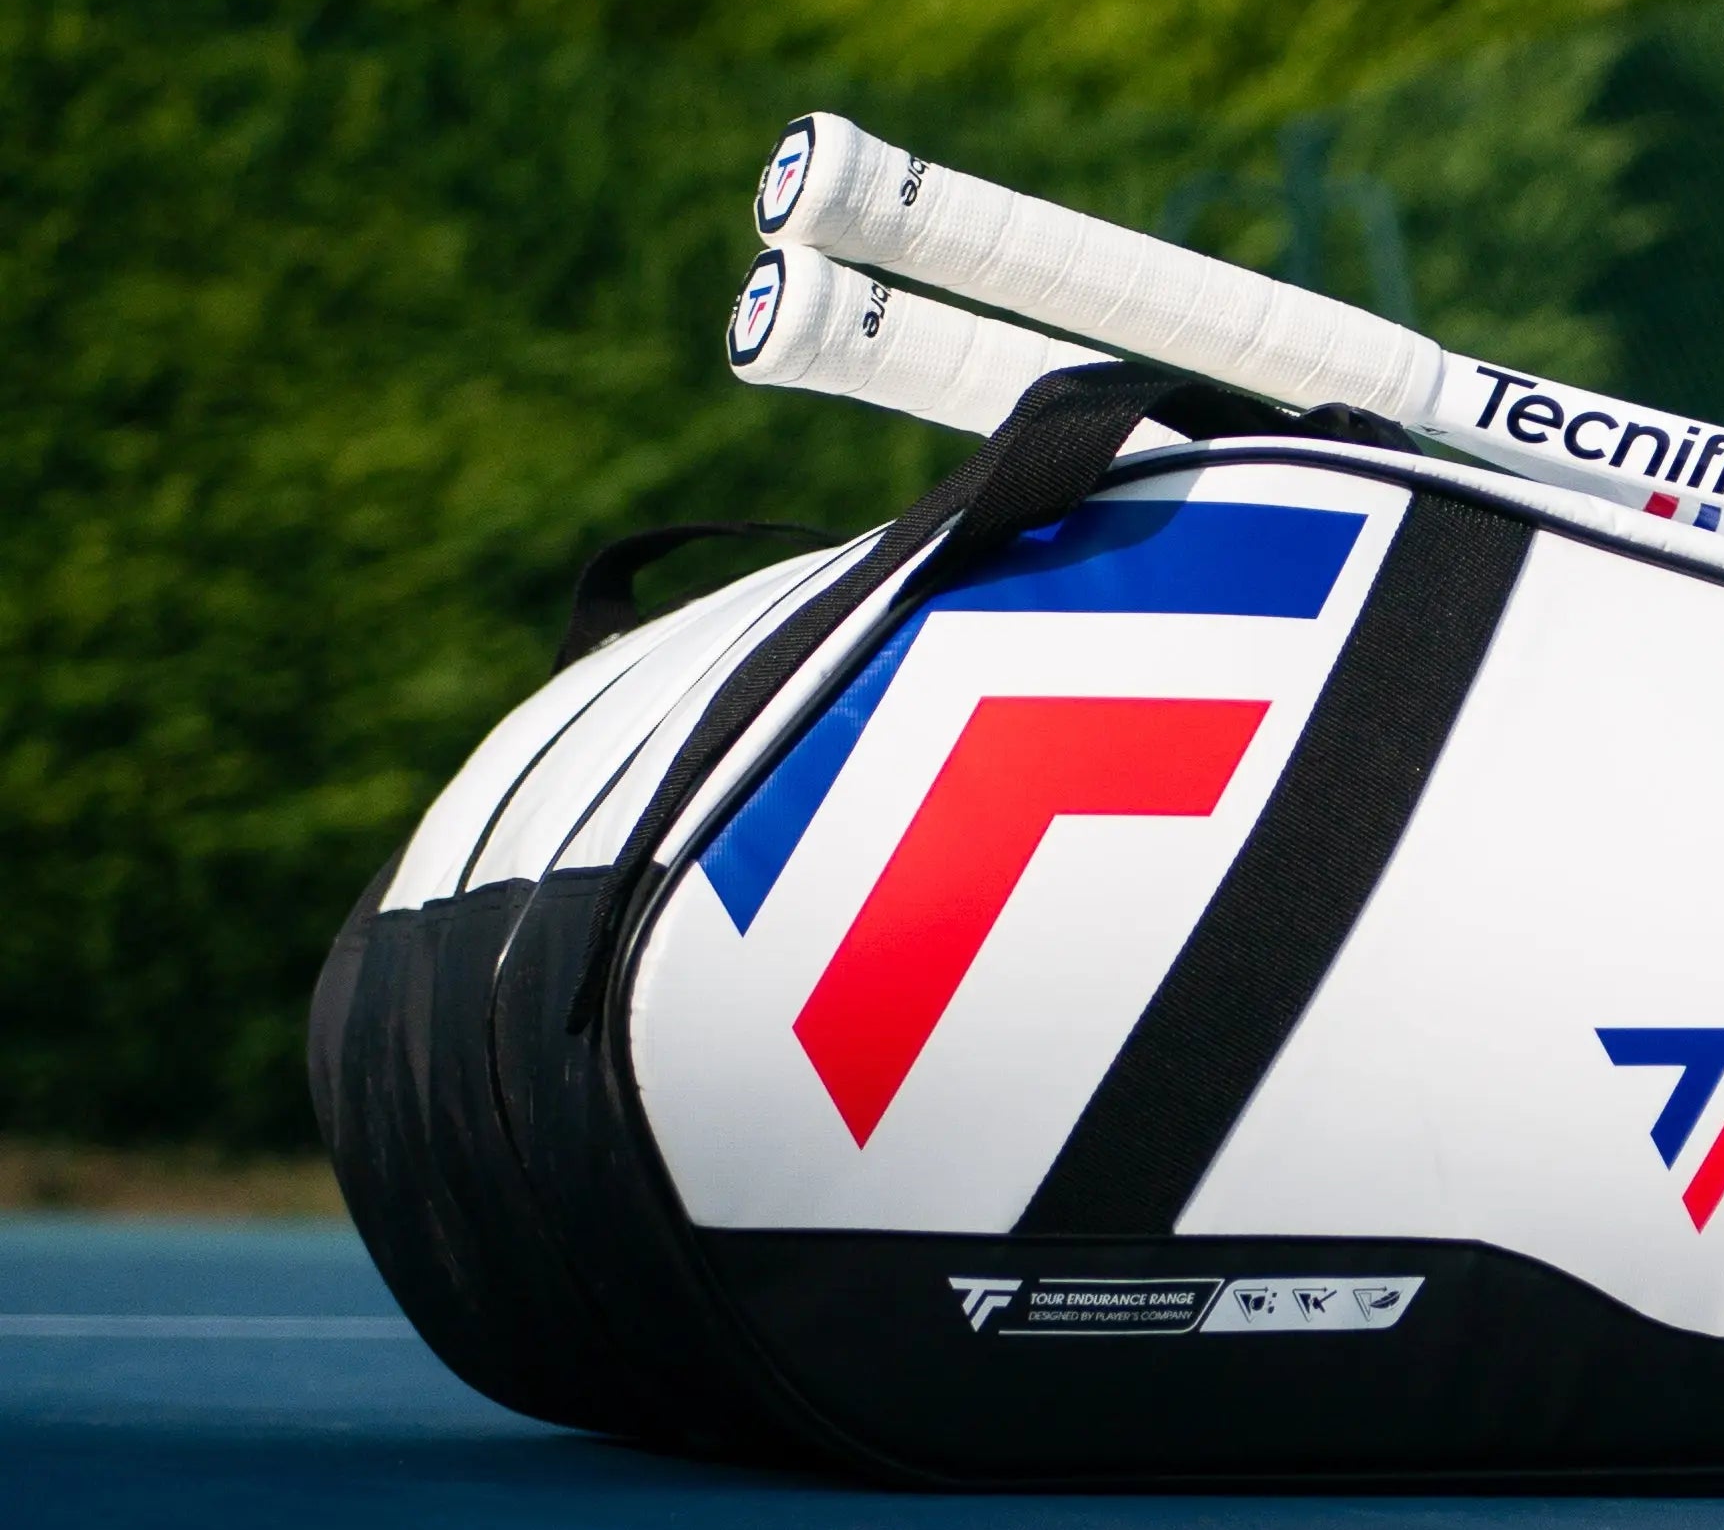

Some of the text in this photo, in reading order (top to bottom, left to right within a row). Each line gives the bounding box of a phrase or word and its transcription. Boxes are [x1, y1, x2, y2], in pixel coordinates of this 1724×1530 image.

[1030, 1292, 1196, 1306] TOUR ENDURANCE RANGE
[1028, 1311, 1079, 1321] DESIGNED
[1080, 1311, 1094, 1321] BY
[1140, 1310, 1193, 1321] COMPANY
